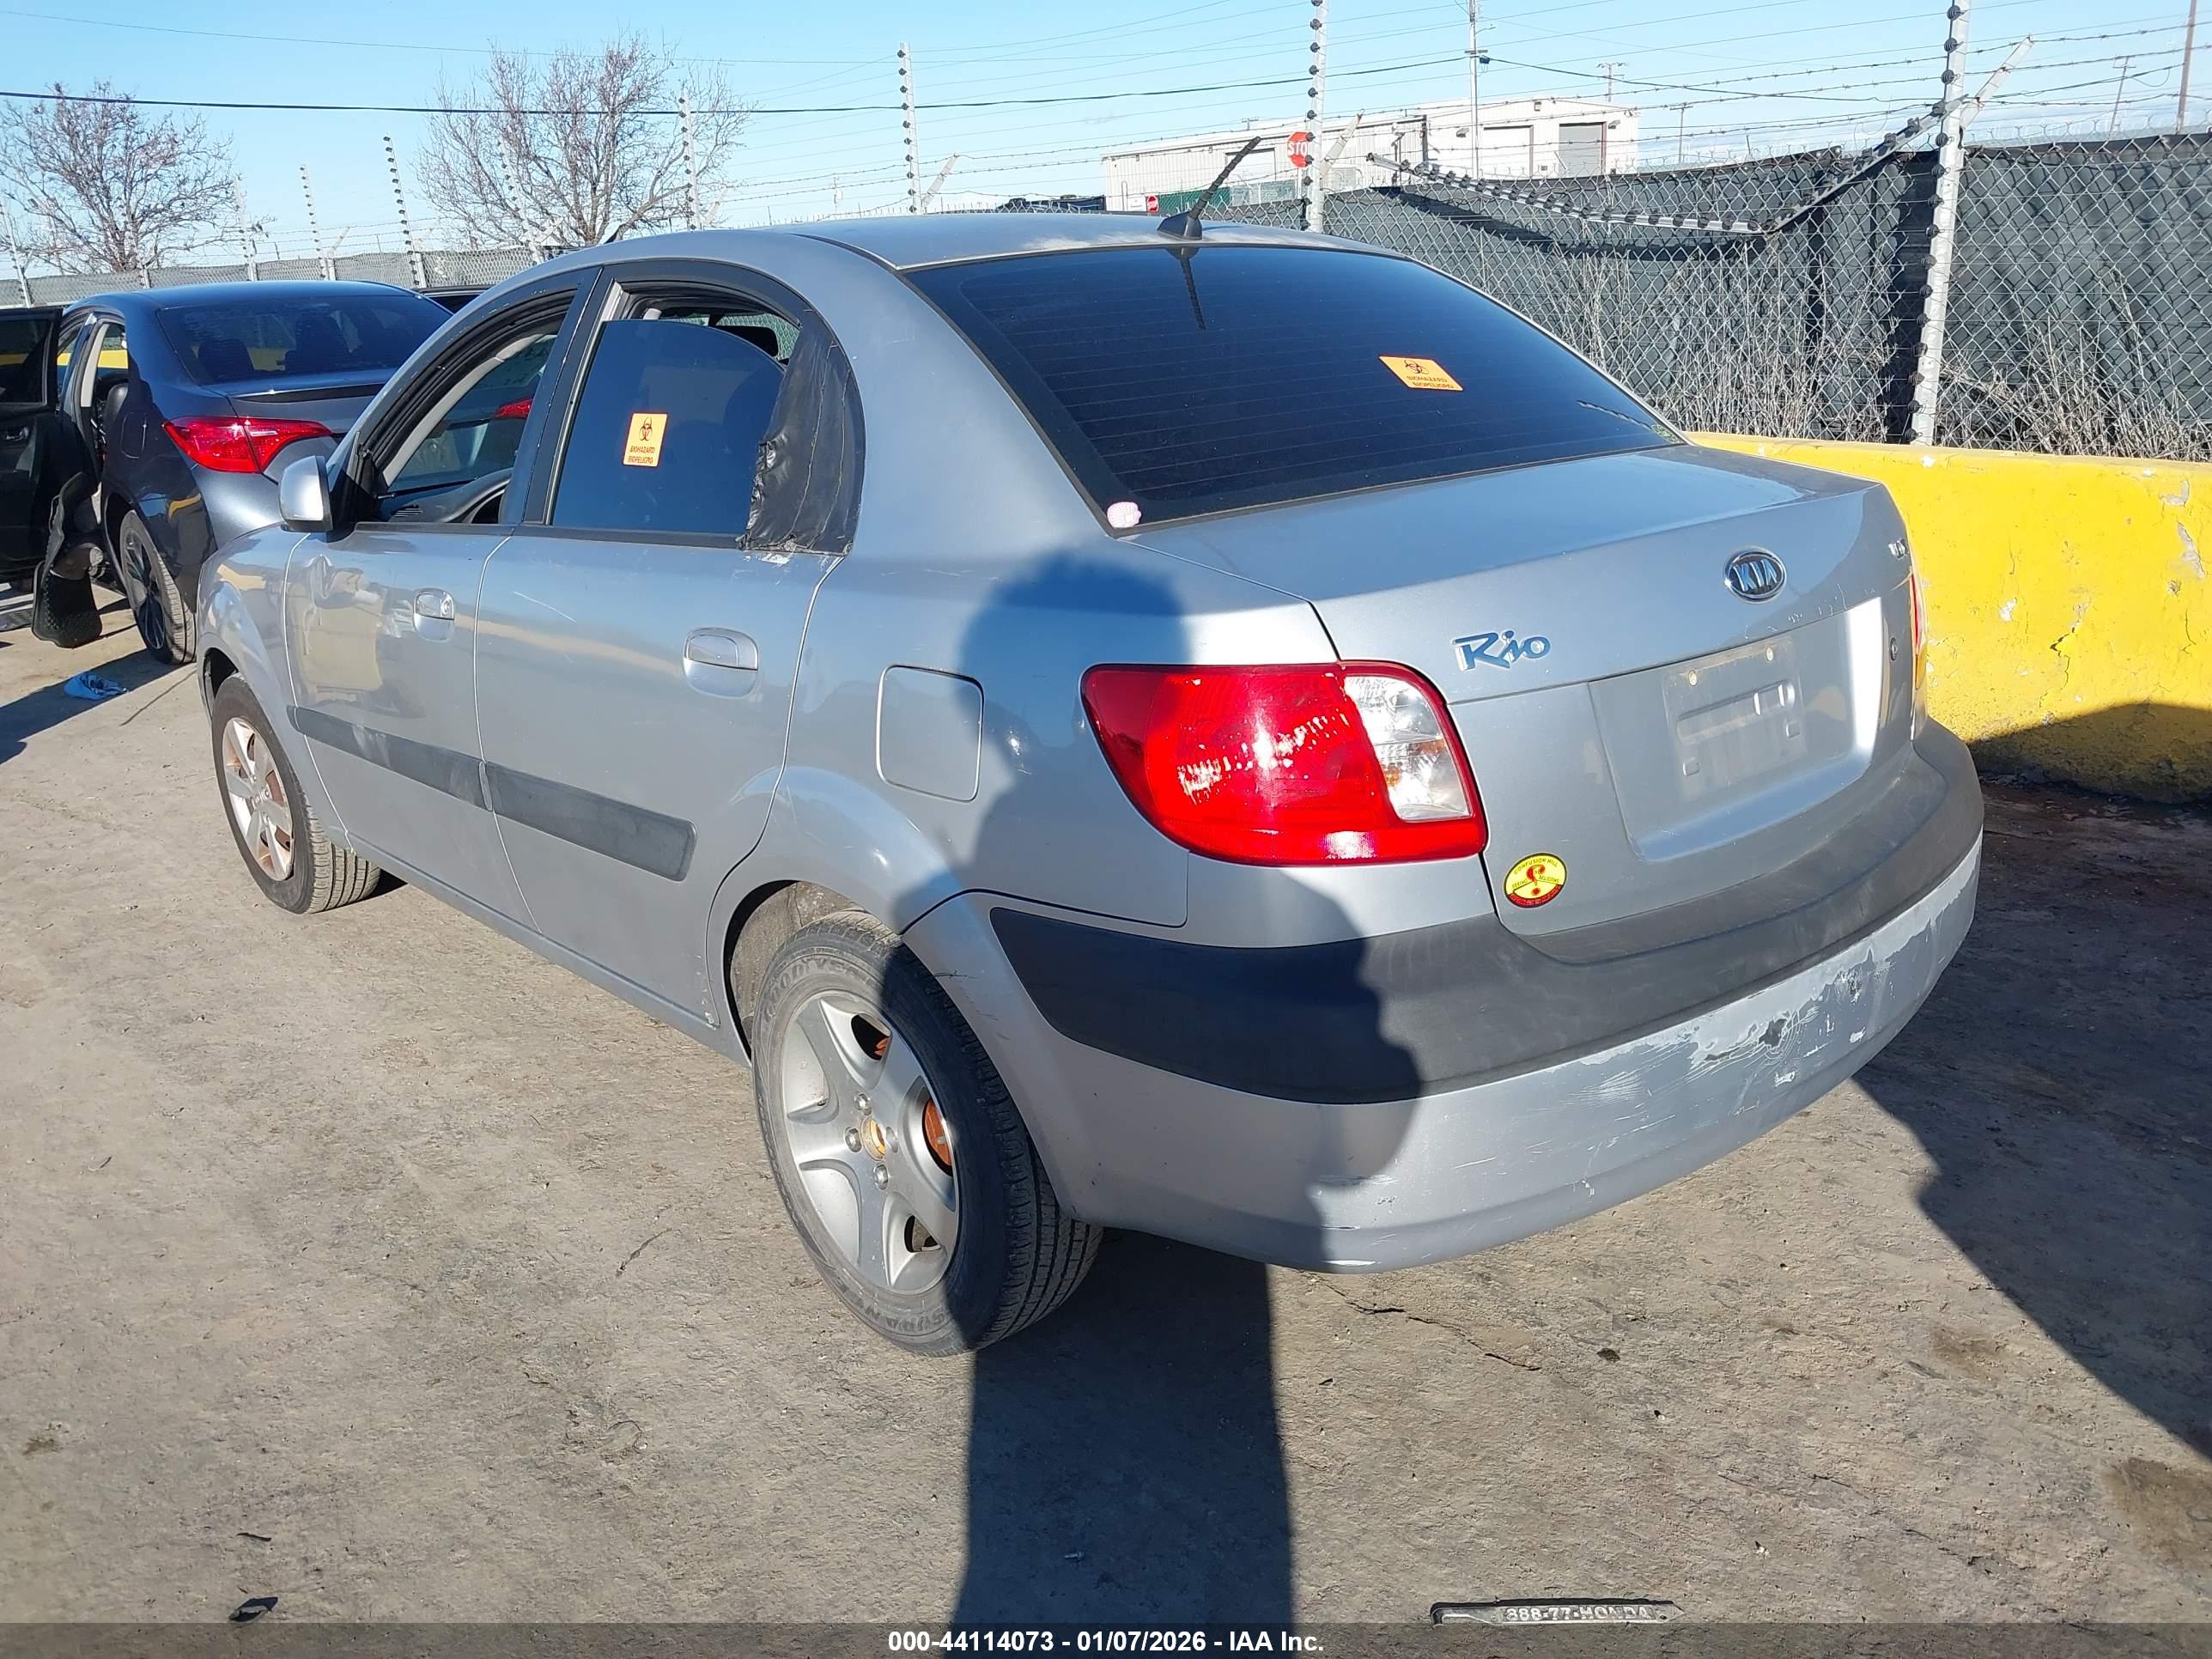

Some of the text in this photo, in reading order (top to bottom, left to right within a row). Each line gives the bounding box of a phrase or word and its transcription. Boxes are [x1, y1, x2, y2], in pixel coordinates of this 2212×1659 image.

[1287, 142, 1308, 156] STO
[629, 445, 655, 453] BIOHAZARD
[1733, 558, 1778, 592] KIA
[1450, 629, 1552, 672] Rio
